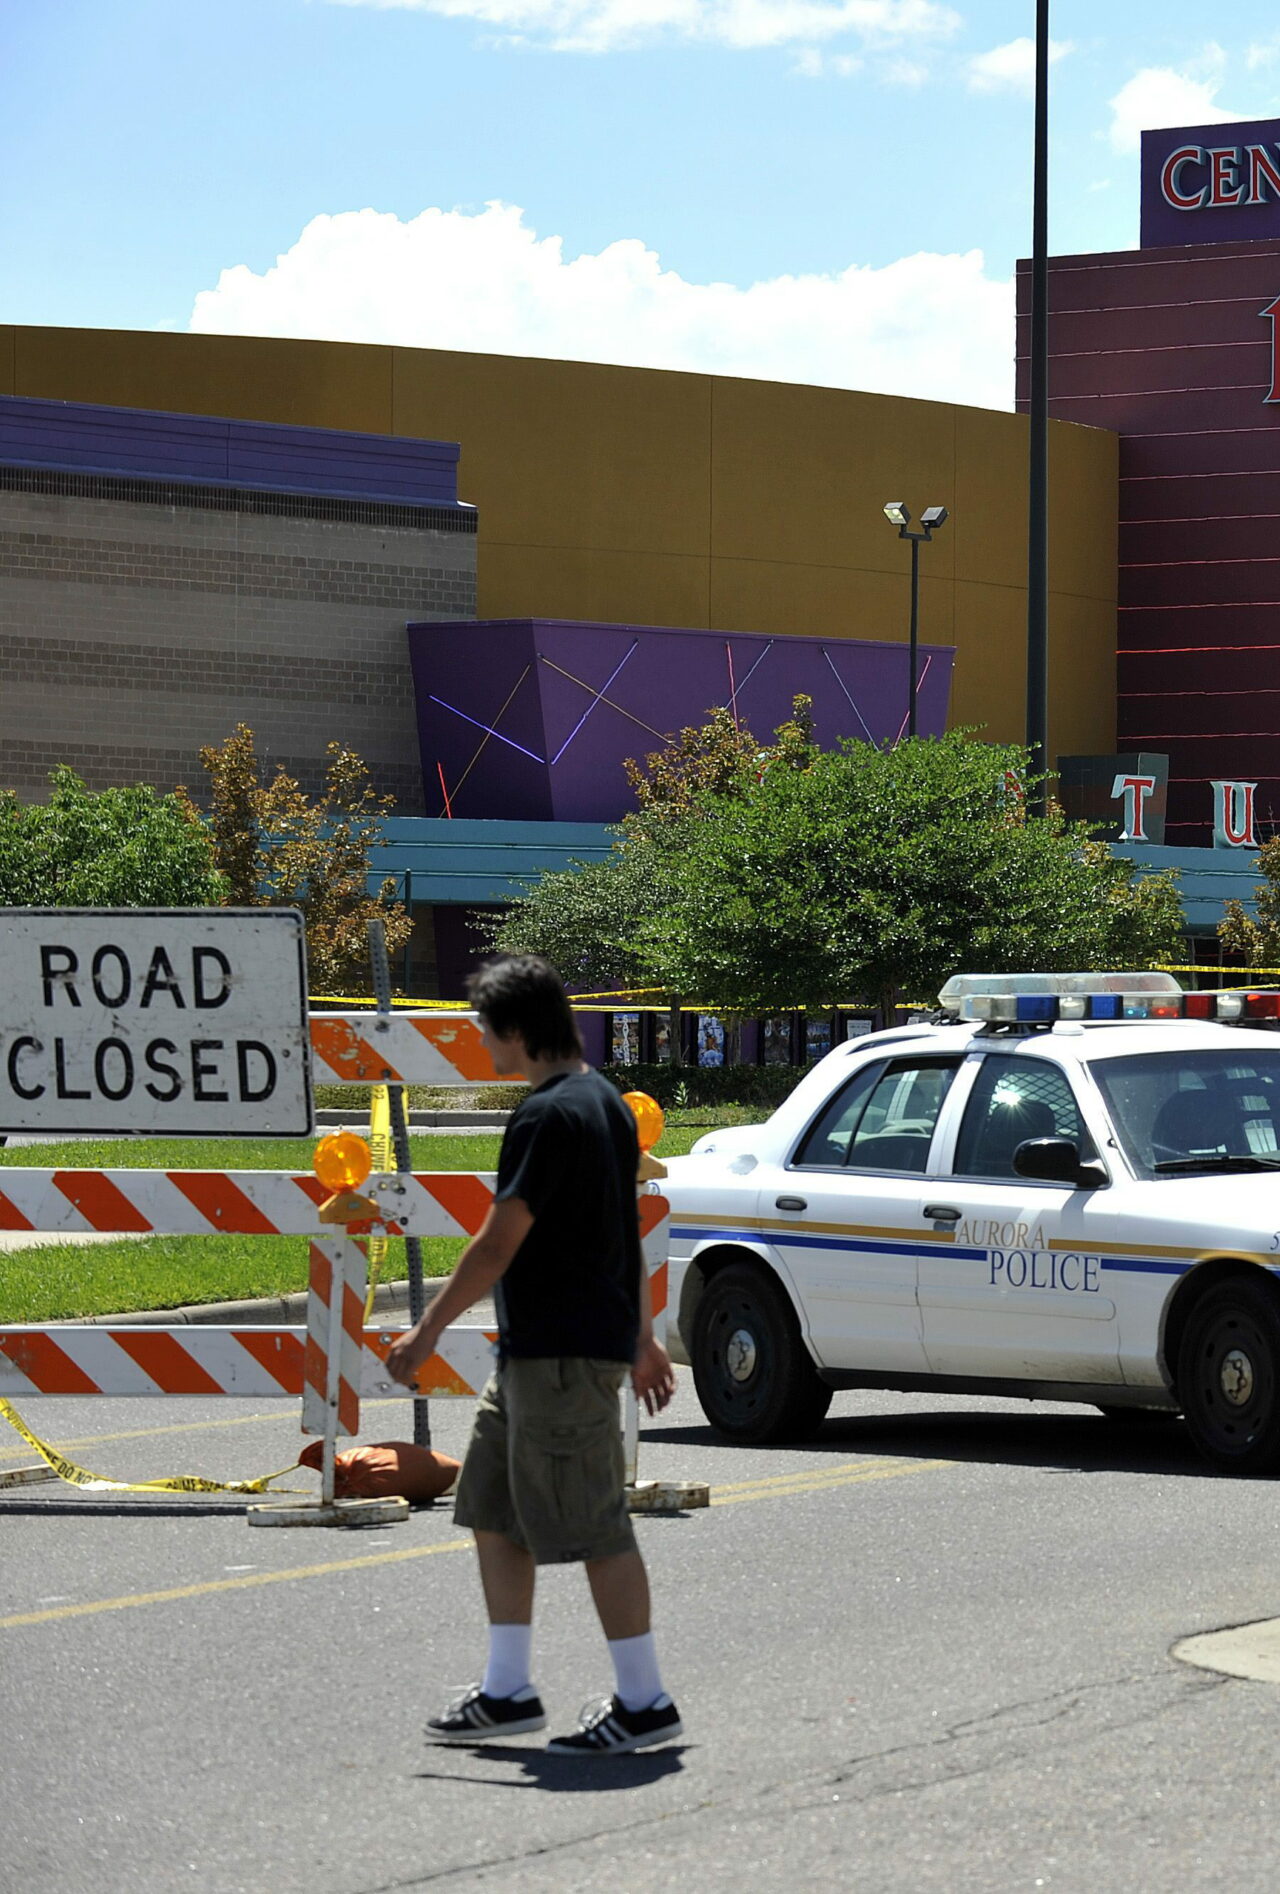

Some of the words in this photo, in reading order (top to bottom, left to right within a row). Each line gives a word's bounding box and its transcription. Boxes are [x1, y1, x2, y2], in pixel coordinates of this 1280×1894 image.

[40, 944, 232, 1009] ROAD
[8, 1036, 277, 1102] CLOSED
[957, 1220, 1045, 1249] AURORA
[989, 1250, 1100, 1292] POLICE
[57, 1462, 75, 1479] DO
